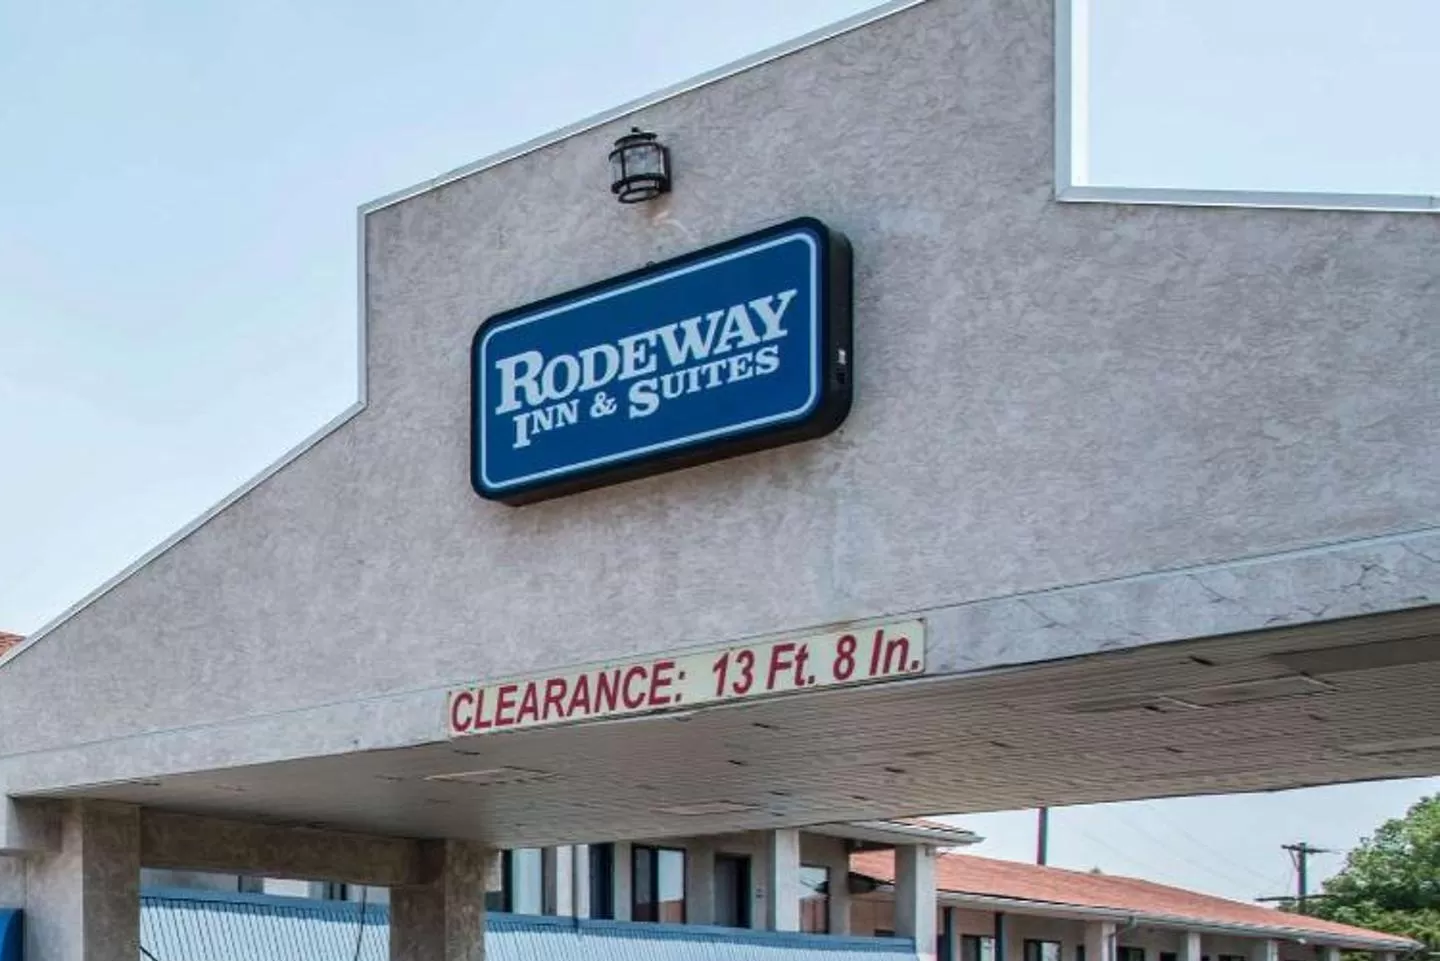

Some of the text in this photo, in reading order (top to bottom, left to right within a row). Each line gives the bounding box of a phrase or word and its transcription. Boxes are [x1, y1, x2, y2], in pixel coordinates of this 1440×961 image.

[495, 289, 798, 415] RODEWAY
[512, 344, 781, 449] INN & SUITES
[450, 629, 920, 734] CLEARANCE: 13 Ft. 8 In.
